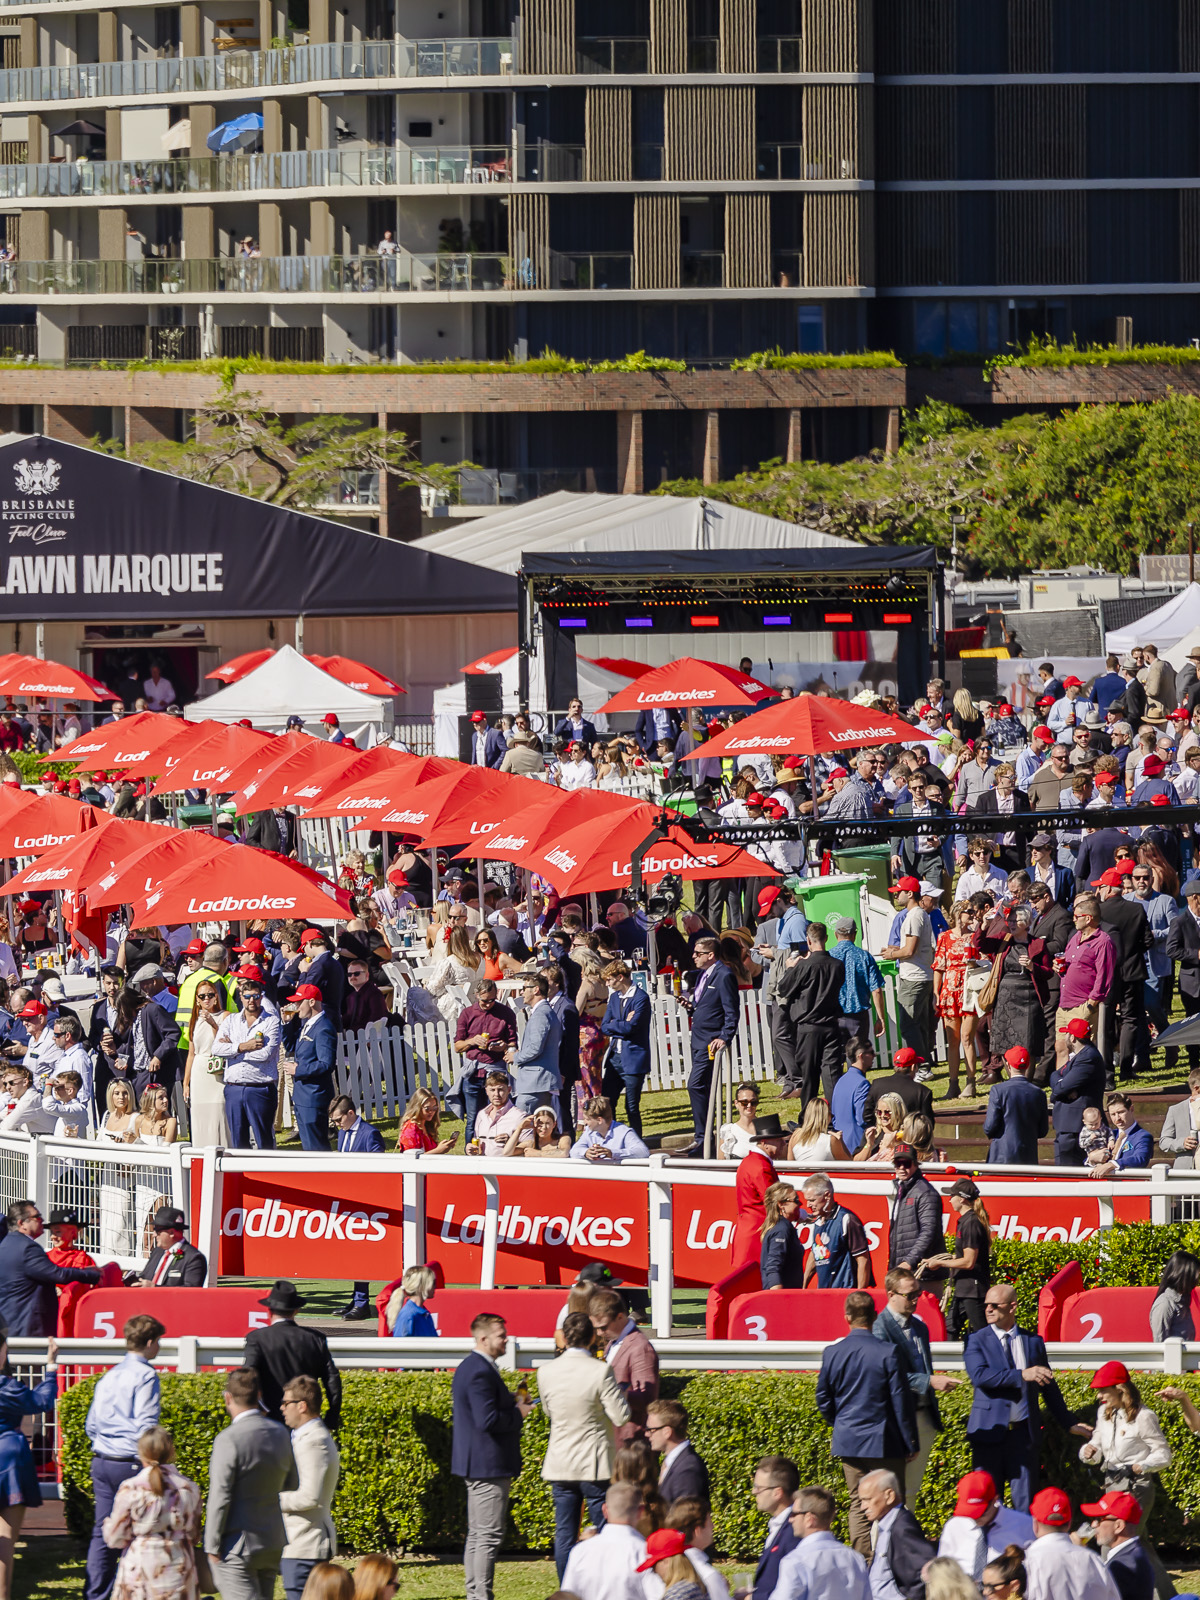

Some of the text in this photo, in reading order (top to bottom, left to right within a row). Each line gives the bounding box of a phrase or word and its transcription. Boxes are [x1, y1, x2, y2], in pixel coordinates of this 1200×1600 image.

[2, 500, 75, 510] BRISBANE
[48, 512, 75, 520] CLUB
[8, 525, 34, 543] Feel
[1150, 557, 1200, 568] TOILES
[83, 553, 224, 596] MARQUEE
[19, 683, 76, 694] Ladbrokes
[637, 690, 717, 703] Ladbrokes
[725, 734, 796, 750] Ladbrokes
[828, 726, 897, 743] Ladbrokes
[337, 796, 391, 809] Ladbroke
[187, 895, 296, 914] Ladbrokes
[222, 1198, 390, 1242] adbrokes
[93, 1312, 116, 1339] 5
[744, 1316, 768, 1341] 3
[1080, 1313, 1104, 1342] 2
